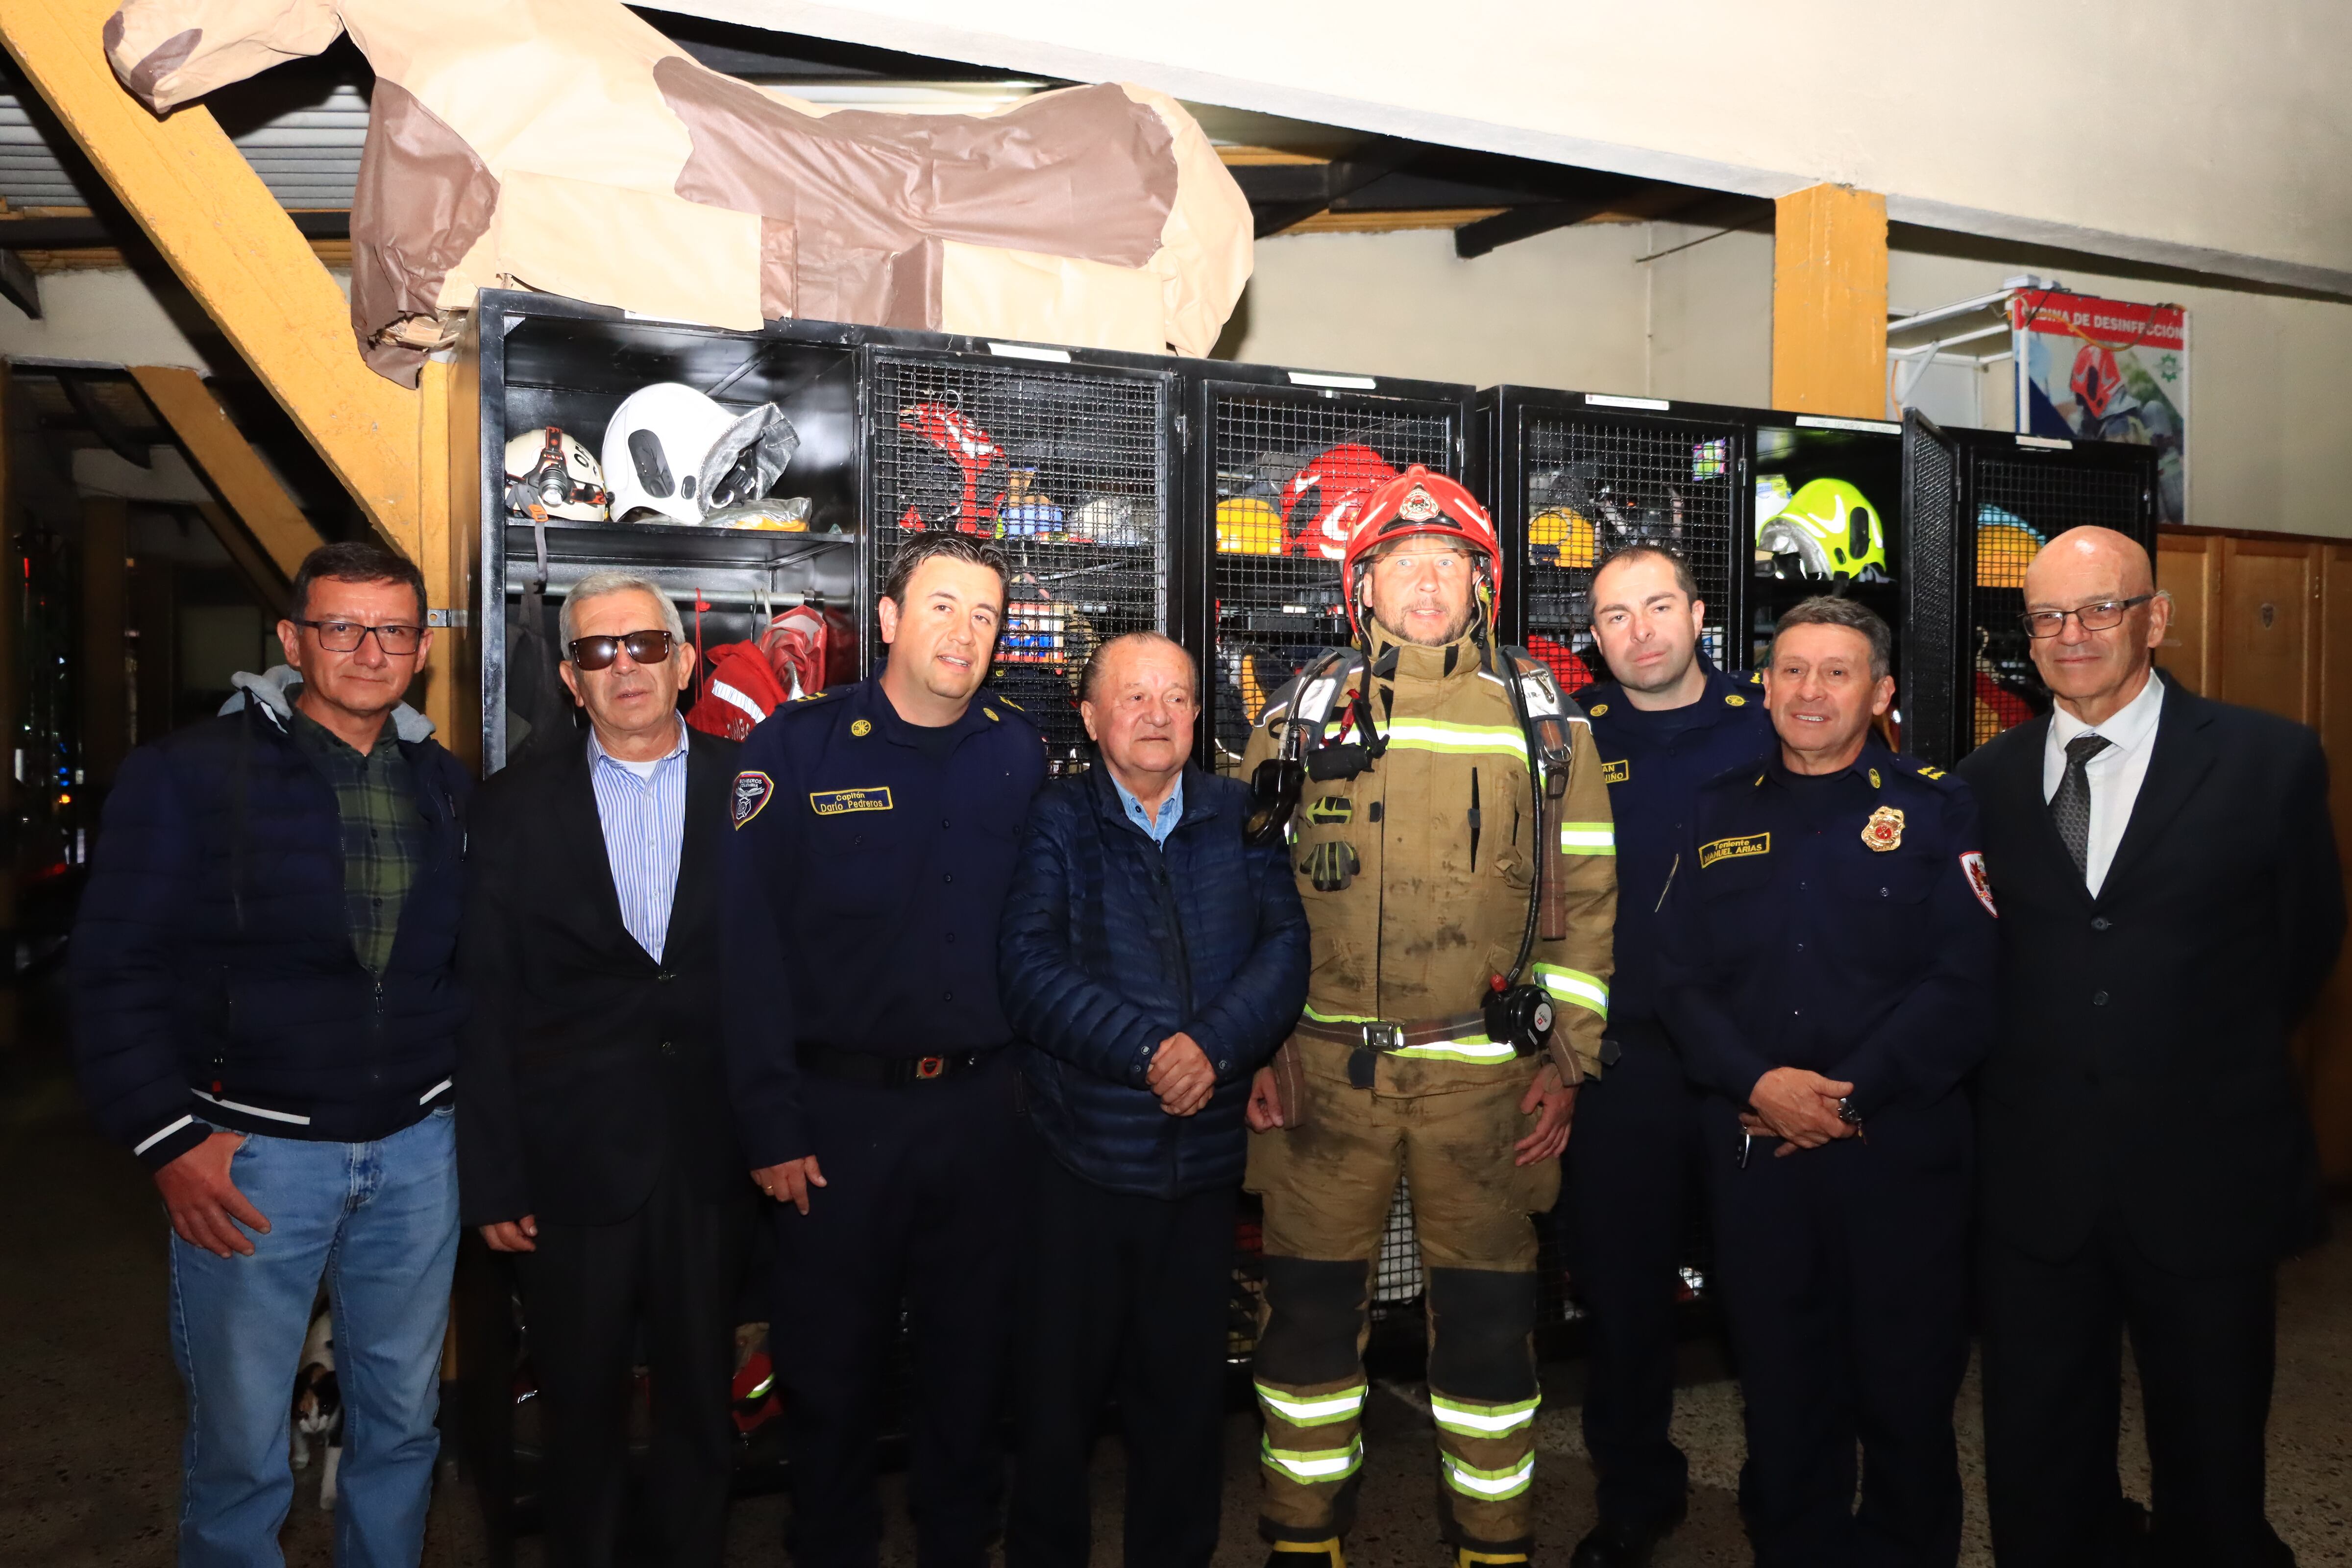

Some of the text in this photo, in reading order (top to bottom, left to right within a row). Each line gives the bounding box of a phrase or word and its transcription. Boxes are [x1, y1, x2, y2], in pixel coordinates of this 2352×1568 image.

[2073, 312, 2090, 326] DE
[836, 791, 865, 802] Capitán
[820, 799, 883, 812] Darío Pedreros
[1714, 839, 1750, 850] Teniente
[1704, 843, 1763, 863] MANUEL ARIAS
